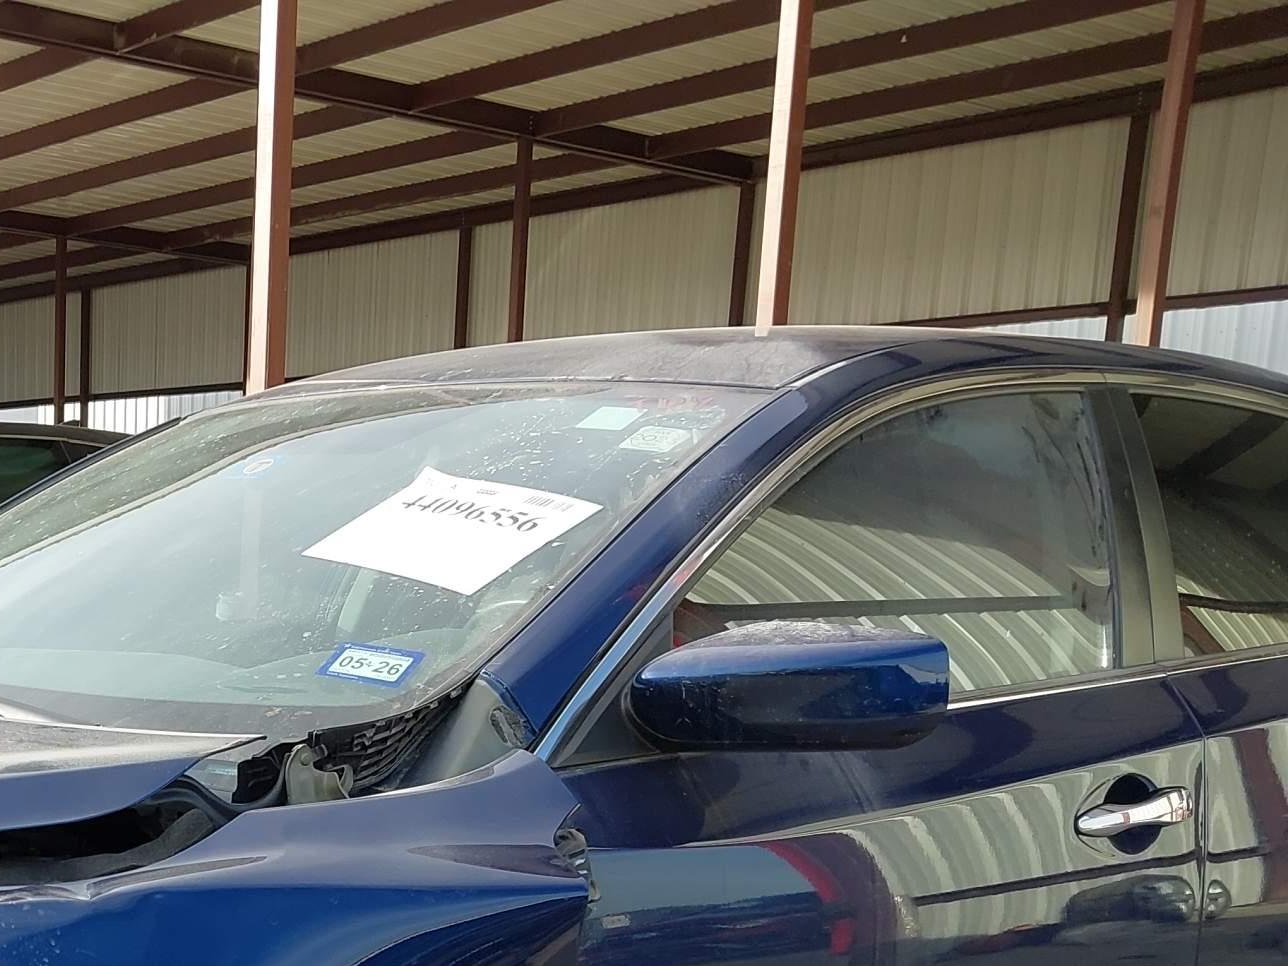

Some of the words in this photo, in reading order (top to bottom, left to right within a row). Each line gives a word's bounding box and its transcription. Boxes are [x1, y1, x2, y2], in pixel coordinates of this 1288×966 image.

[402, 495, 546, 532] 44096556
[339, 655, 368, 670] 05
[372, 661, 403, 676] 26
